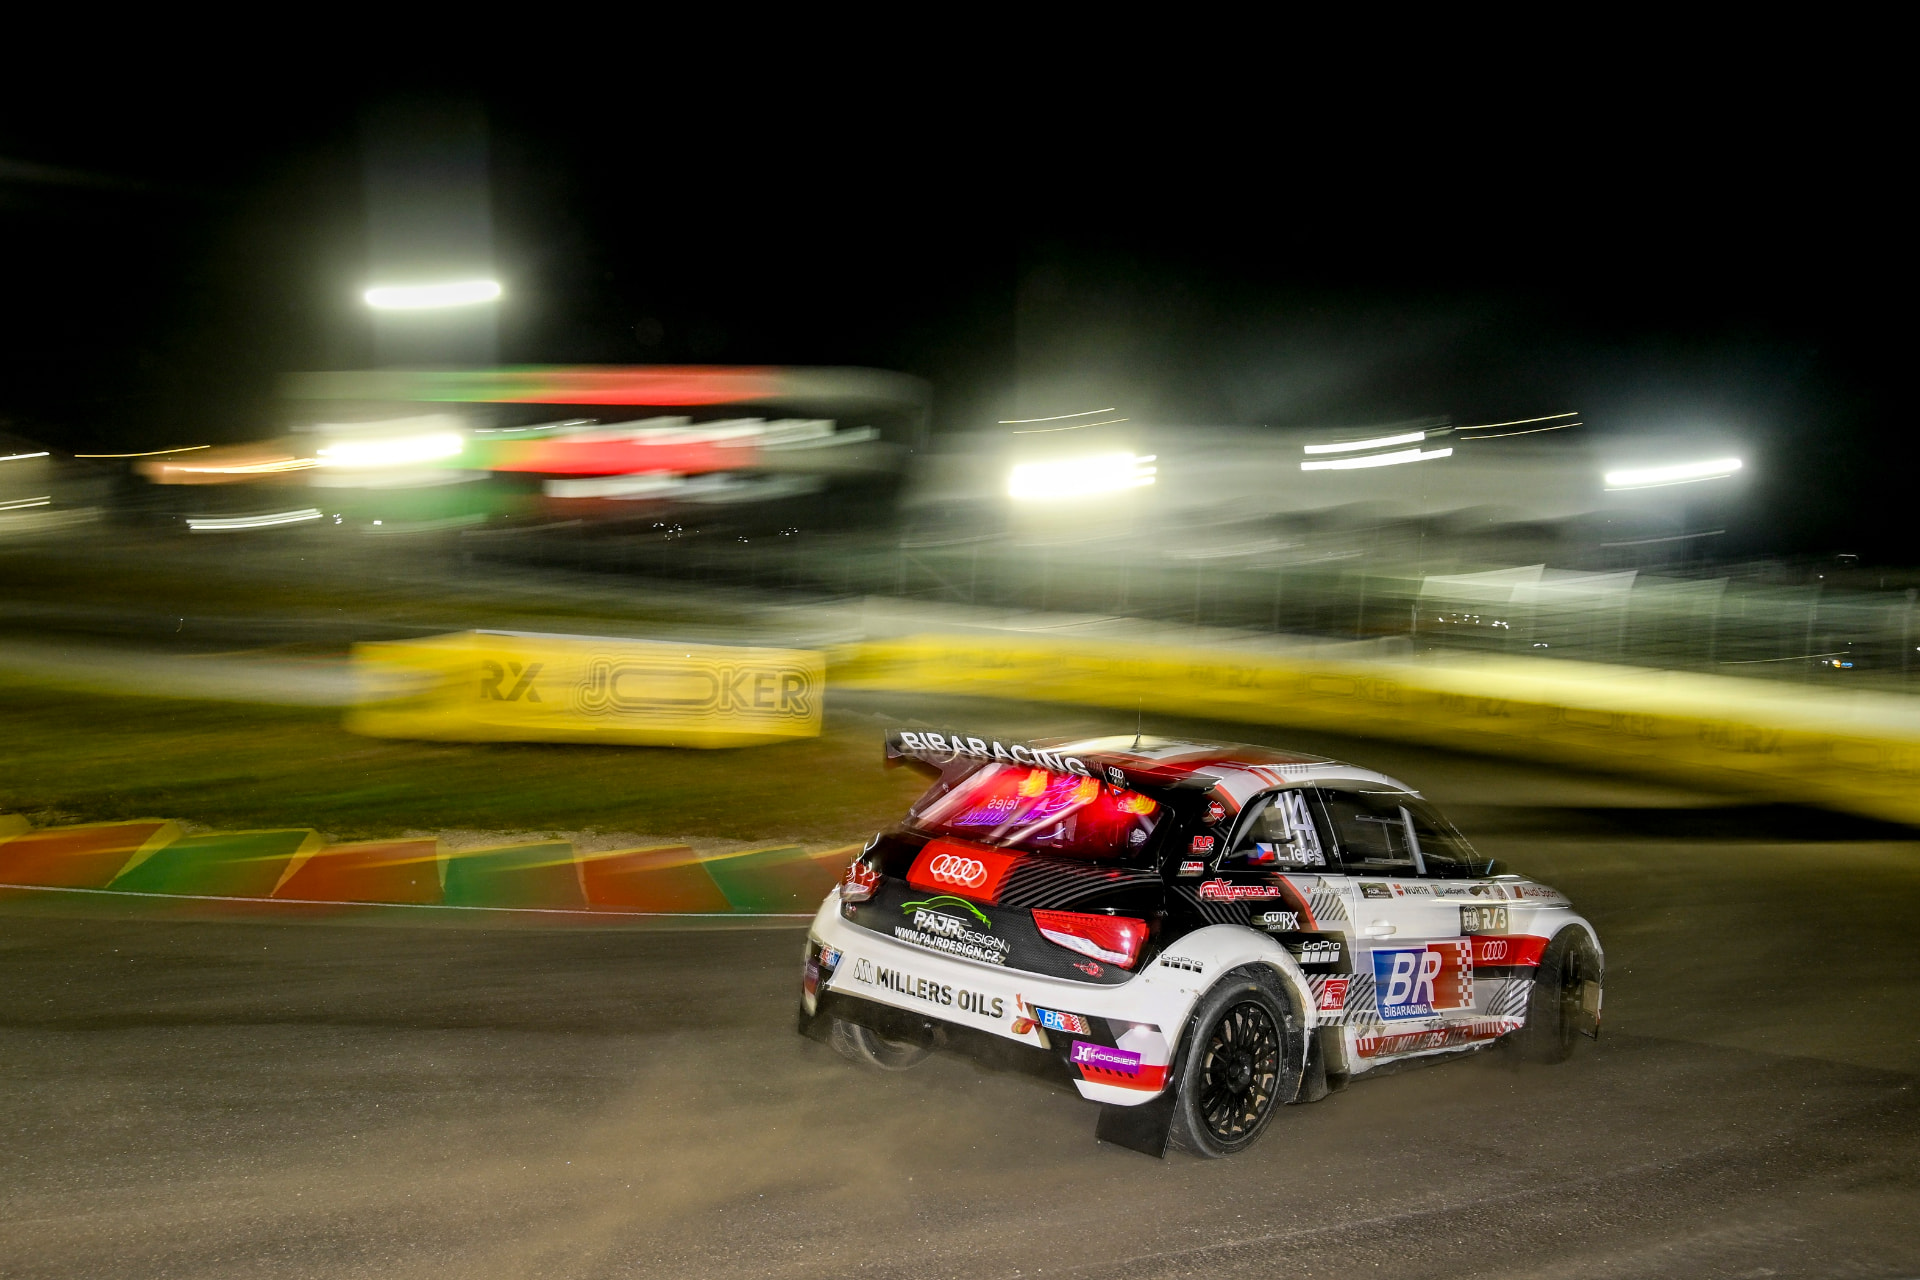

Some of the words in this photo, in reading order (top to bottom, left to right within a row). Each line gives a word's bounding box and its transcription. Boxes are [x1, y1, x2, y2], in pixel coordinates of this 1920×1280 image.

[479, 659, 544, 703] RX
[584, 665, 808, 713] JOKER
[900, 731, 1091, 777] BIBARACING
[1275, 791, 1317, 840] 14
[1200, 878, 1281, 900] rallycross.cz
[894, 925, 1001, 963] WWW.PAJRDESIGN.CZ
[1161, 953, 1204, 967] GoPro
[1302, 941, 1341, 951] GoPro
[876, 965, 953, 1006] MILLERS
[957, 989, 1004, 1019] OILS
[1386, 951, 1443, 1005] BR
[1044, 1012, 1065, 1028] BR
[1384, 1004, 1428, 1018] BIBARACING
[1090, 1053, 1137, 1067] HOOSIER
